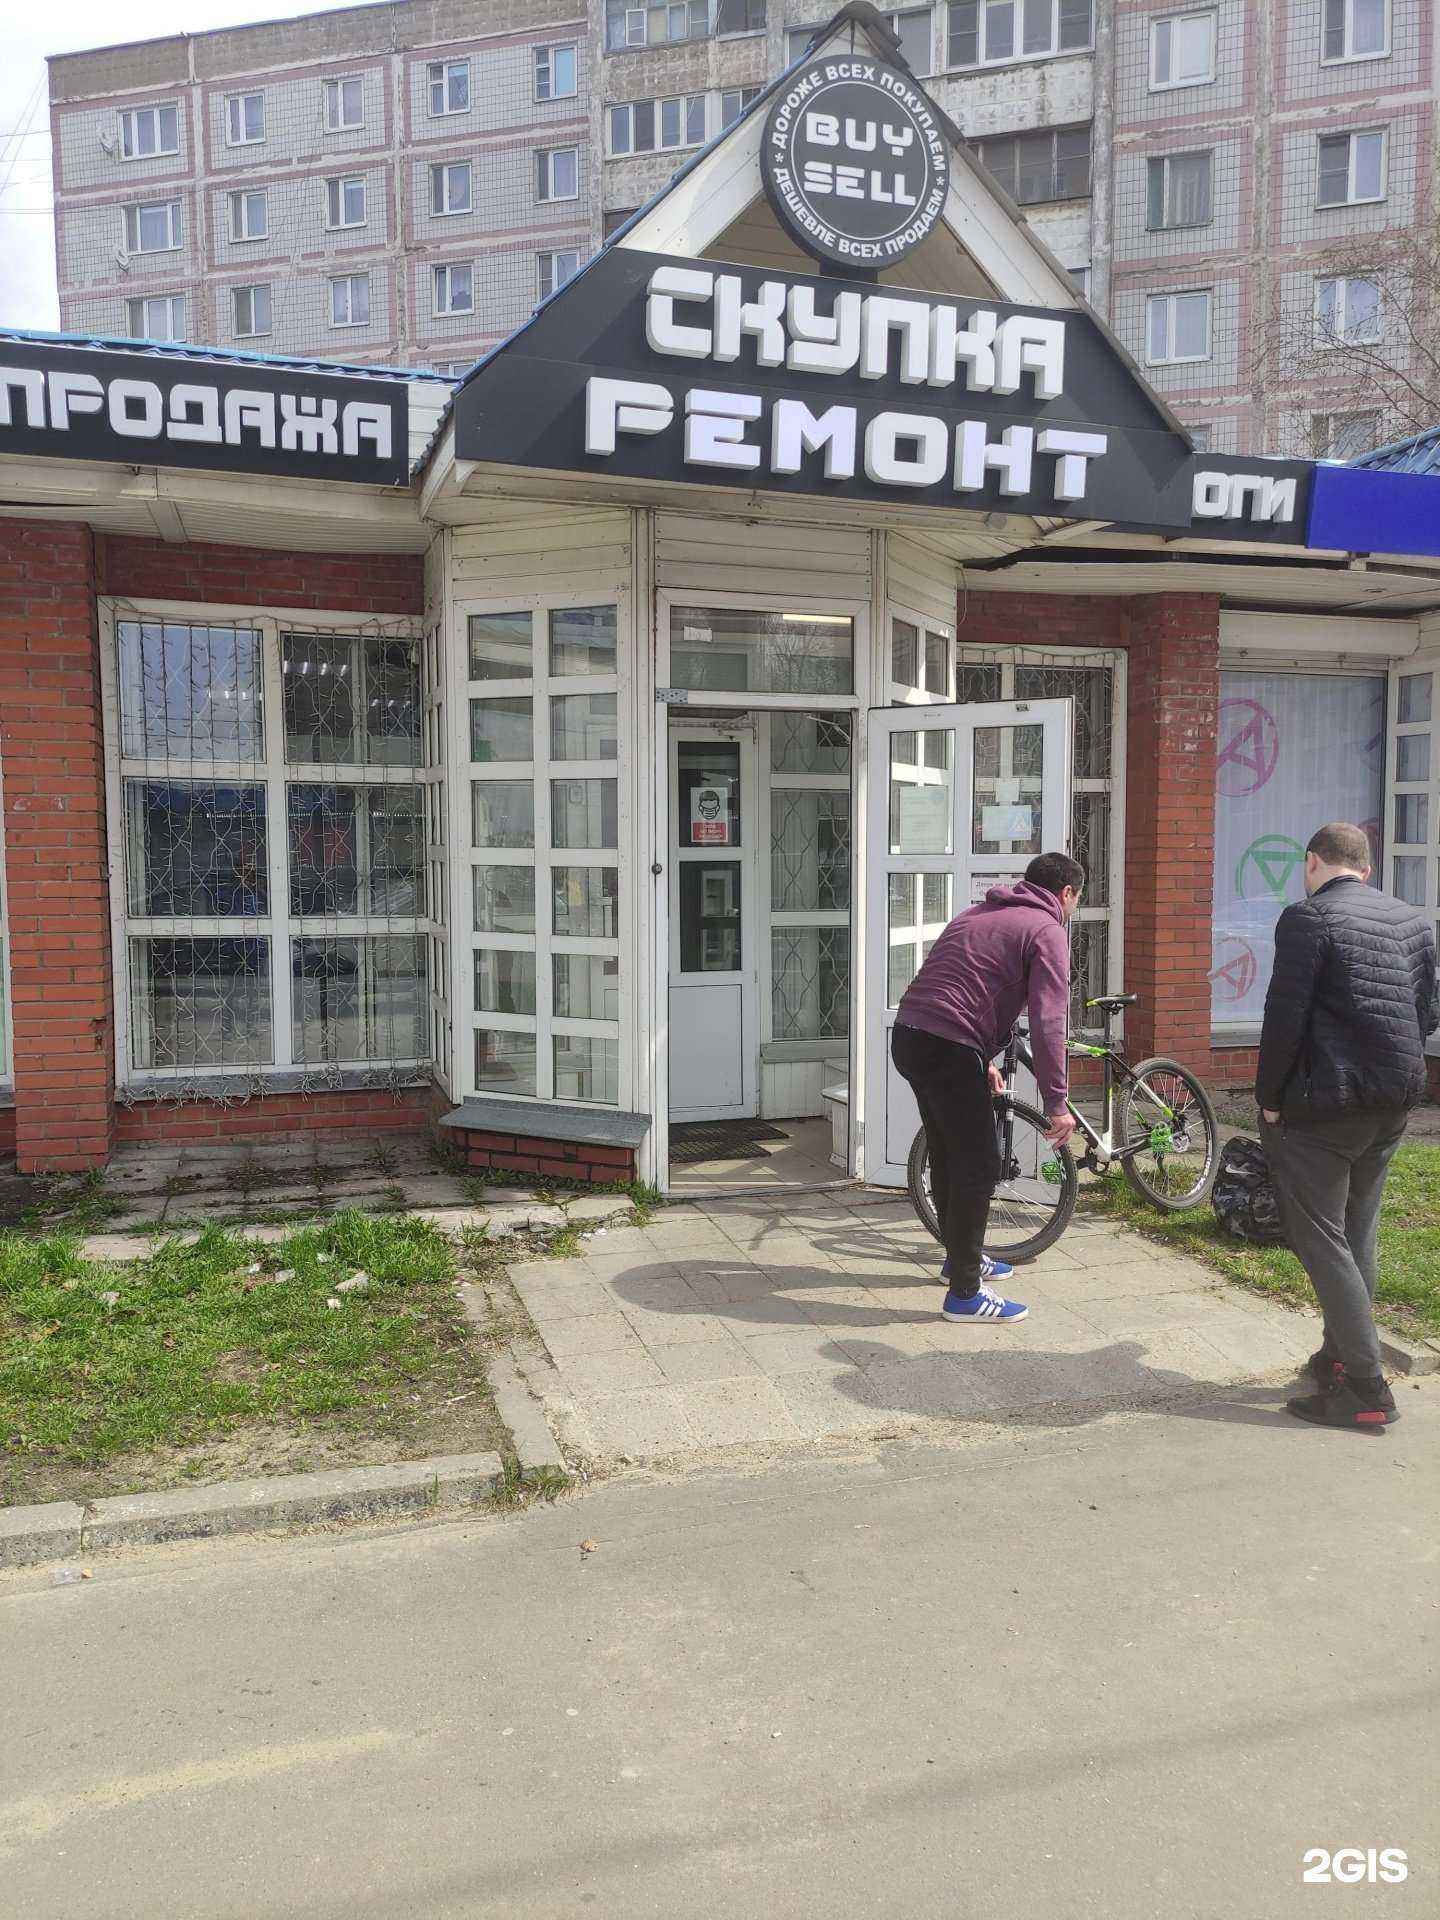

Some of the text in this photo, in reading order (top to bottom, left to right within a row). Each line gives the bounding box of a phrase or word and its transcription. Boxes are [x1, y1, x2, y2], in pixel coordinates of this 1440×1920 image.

[772, 63, 946, 171] ДОРОЖЕ ВСЕХ ПОКУПАЕМ
[806, 112, 914, 157] BUY
[773, 167, 945, 258] ДЕШЕВЛЕ ВСЕХ ПРОДАЕМ
[804, 160, 916, 206] SELL
[645, 266, 1066, 400] СКУПКА
[0, 366, 393, 459] ПРОДАЖА
[585, 376, 1108, 501] РЕМОНТ
